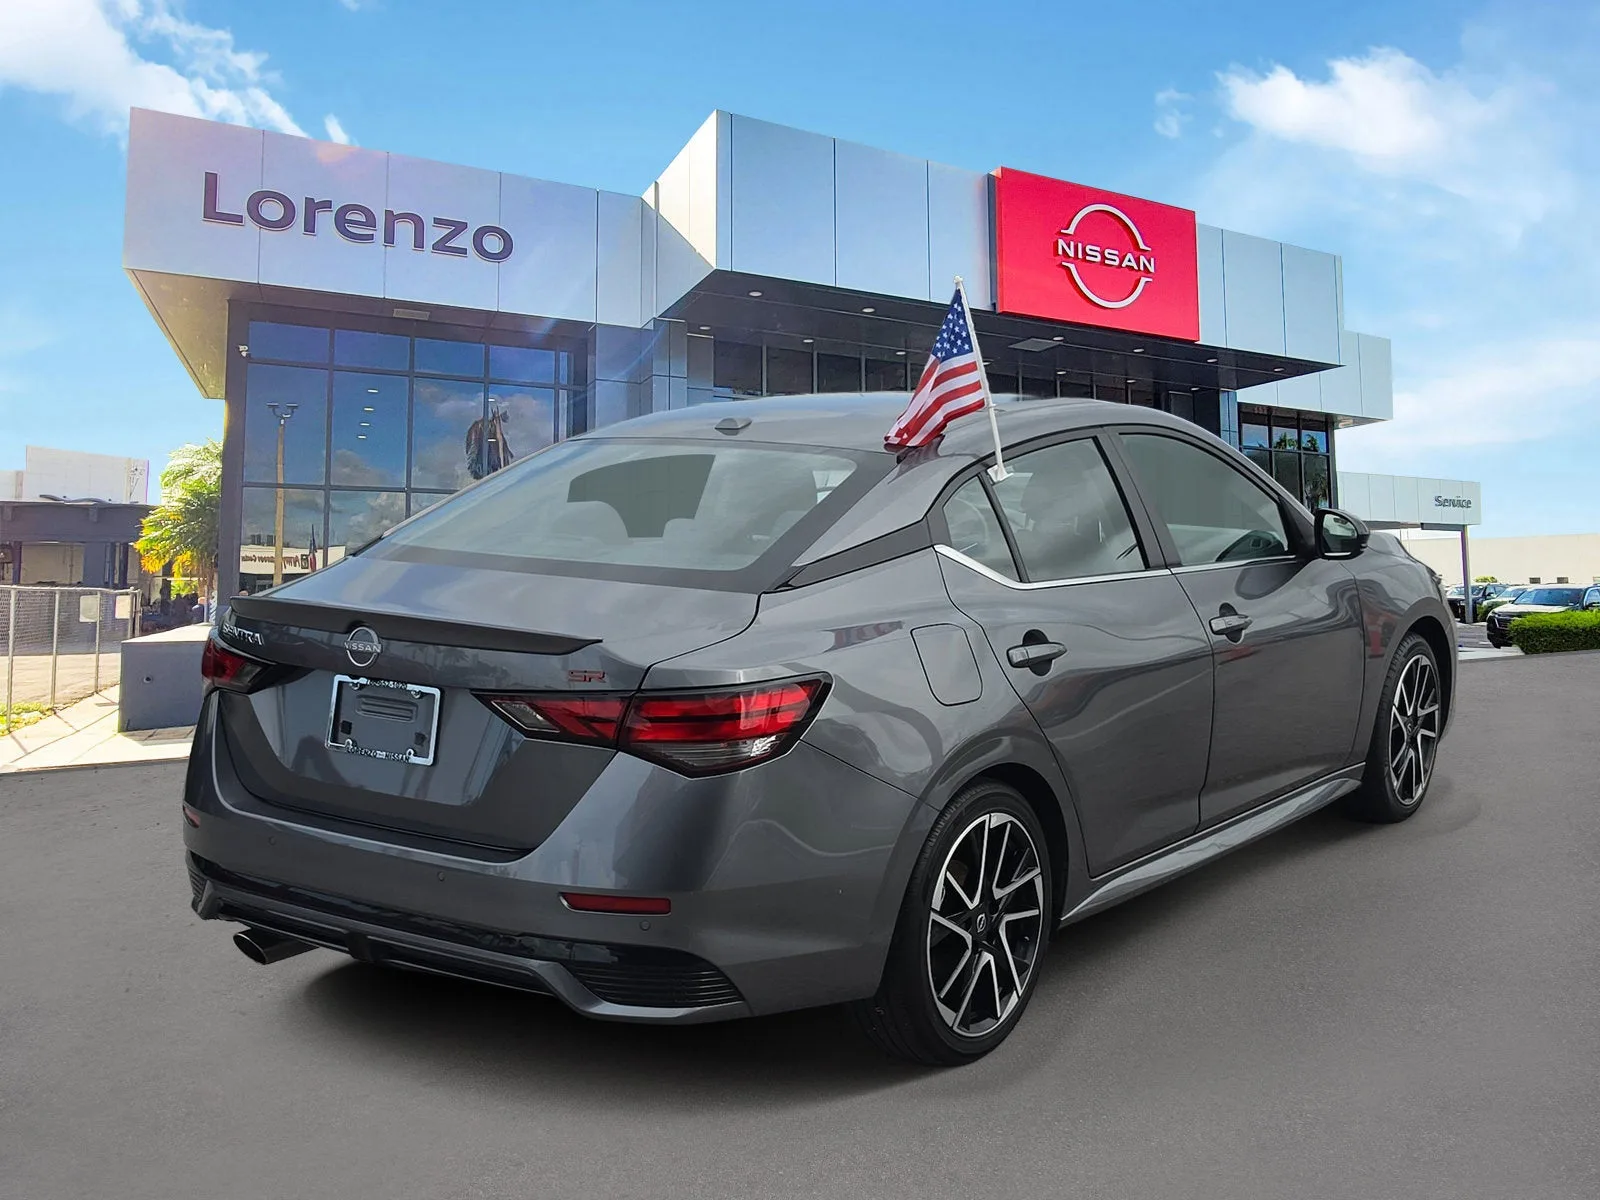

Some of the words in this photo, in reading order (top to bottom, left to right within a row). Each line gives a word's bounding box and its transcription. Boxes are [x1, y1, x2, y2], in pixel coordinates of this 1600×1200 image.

[202, 171, 514, 263] Lorenzo
[1056, 238, 1156, 274] NISSAN
[1434, 495, 1472, 508] Service
[223, 623, 264, 645] SENTRA
[344, 641, 381, 653] NISSAN
[568, 669, 606, 683] SR
